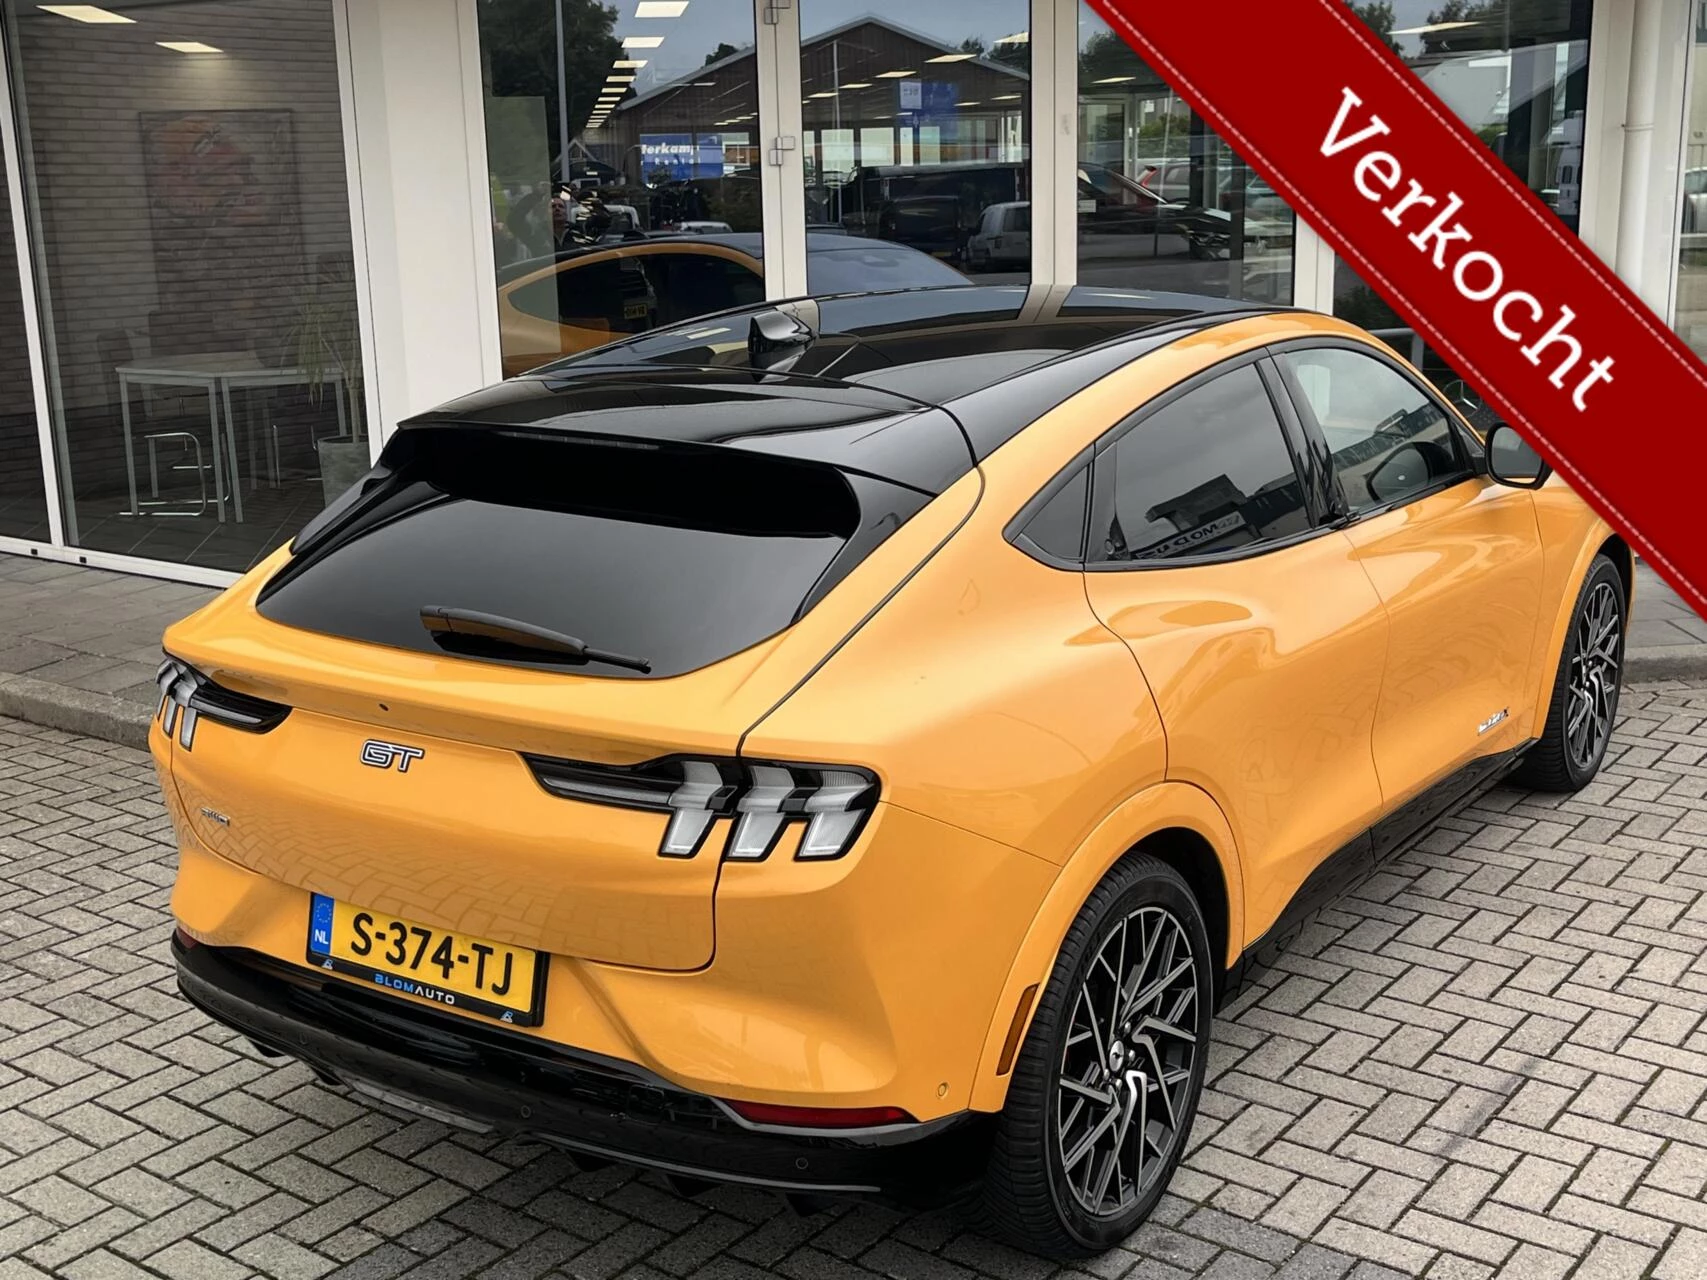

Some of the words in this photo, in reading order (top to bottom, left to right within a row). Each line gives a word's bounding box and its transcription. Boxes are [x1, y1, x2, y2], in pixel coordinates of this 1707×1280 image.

[360, 739, 425, 773] GT
[314, 929, 329, 945] NL
[351, 912, 513, 996] S-374-TJ
[374, 973, 455, 1005] BLOMAUTO
